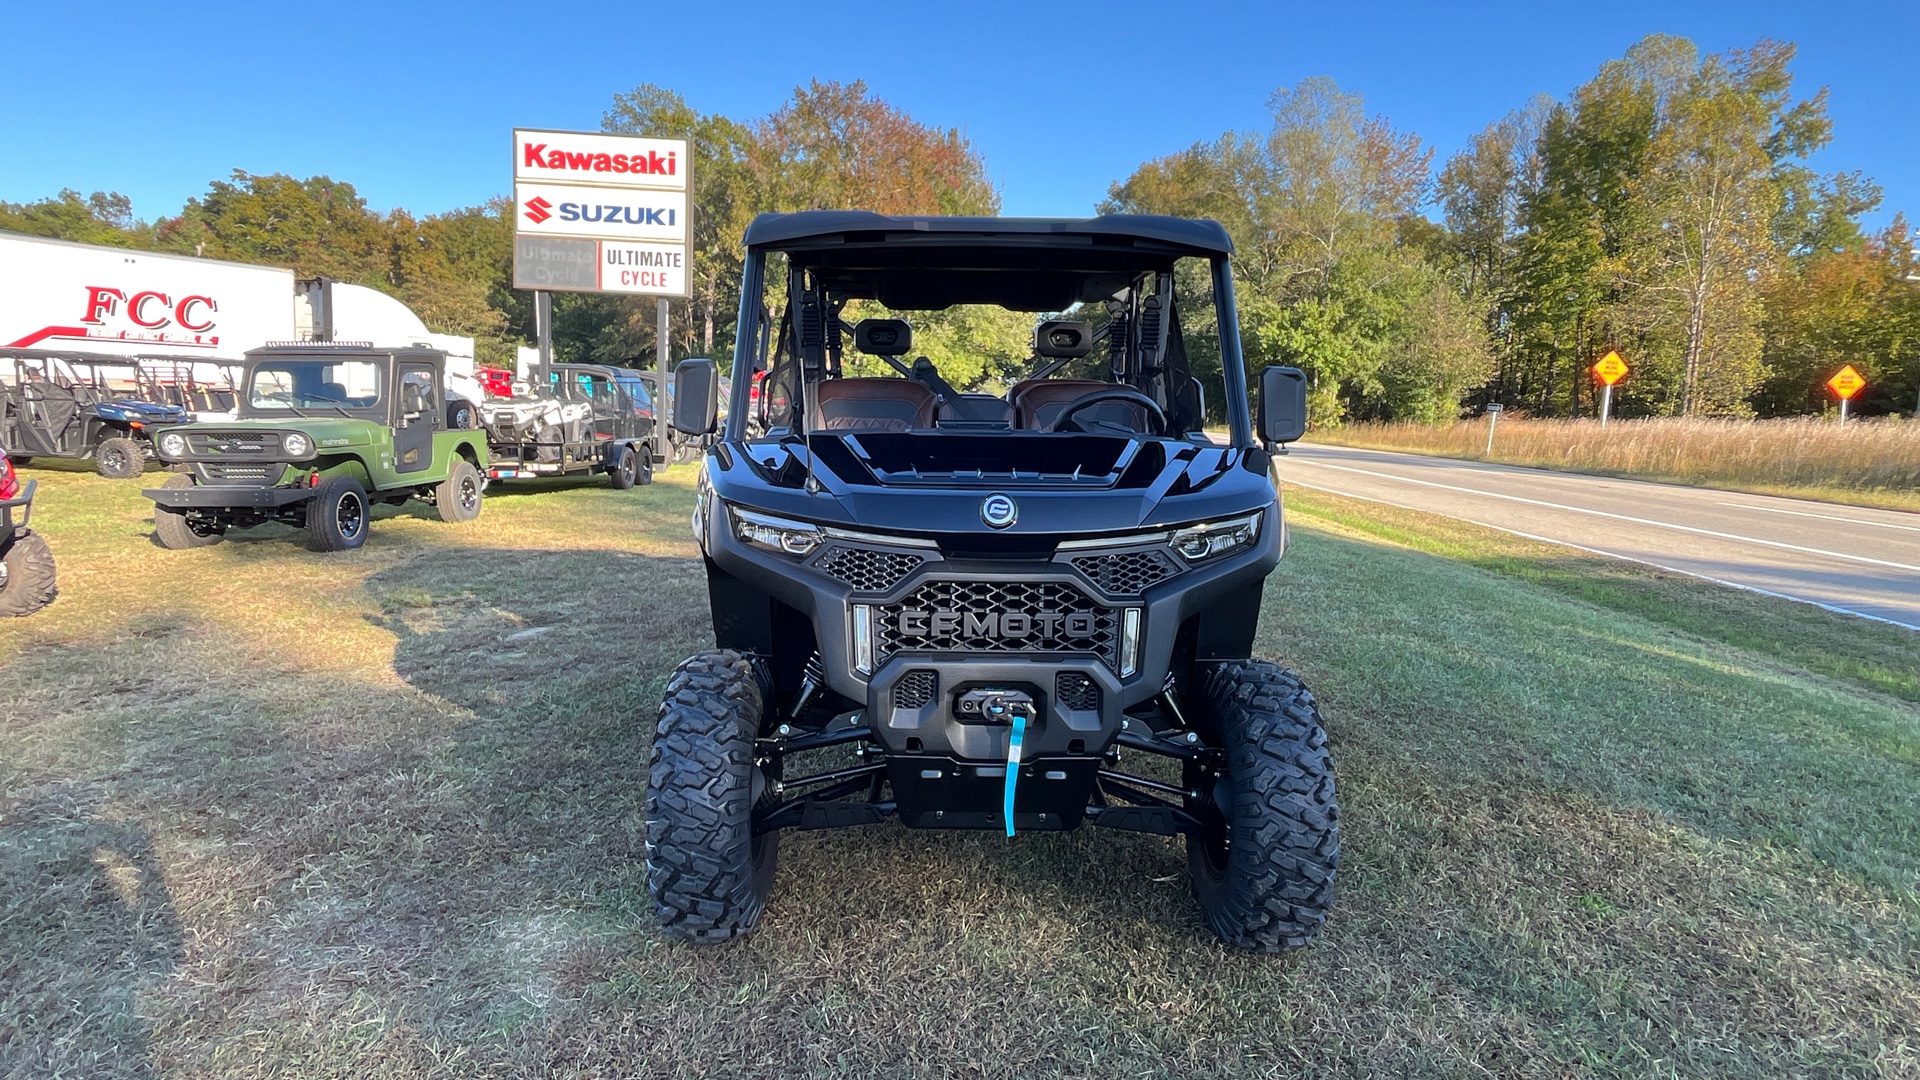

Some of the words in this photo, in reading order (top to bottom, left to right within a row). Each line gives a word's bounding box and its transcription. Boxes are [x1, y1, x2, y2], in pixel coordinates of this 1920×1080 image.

[524, 143, 676, 175] Kawasaki
[559, 202, 675, 226] SUZUKI
[607, 249, 682, 268] ULTIMATE
[621, 270, 667, 287] CYCLE
[80, 286, 218, 333] FCC
[899, 610, 1096, 638] CFMOTO
